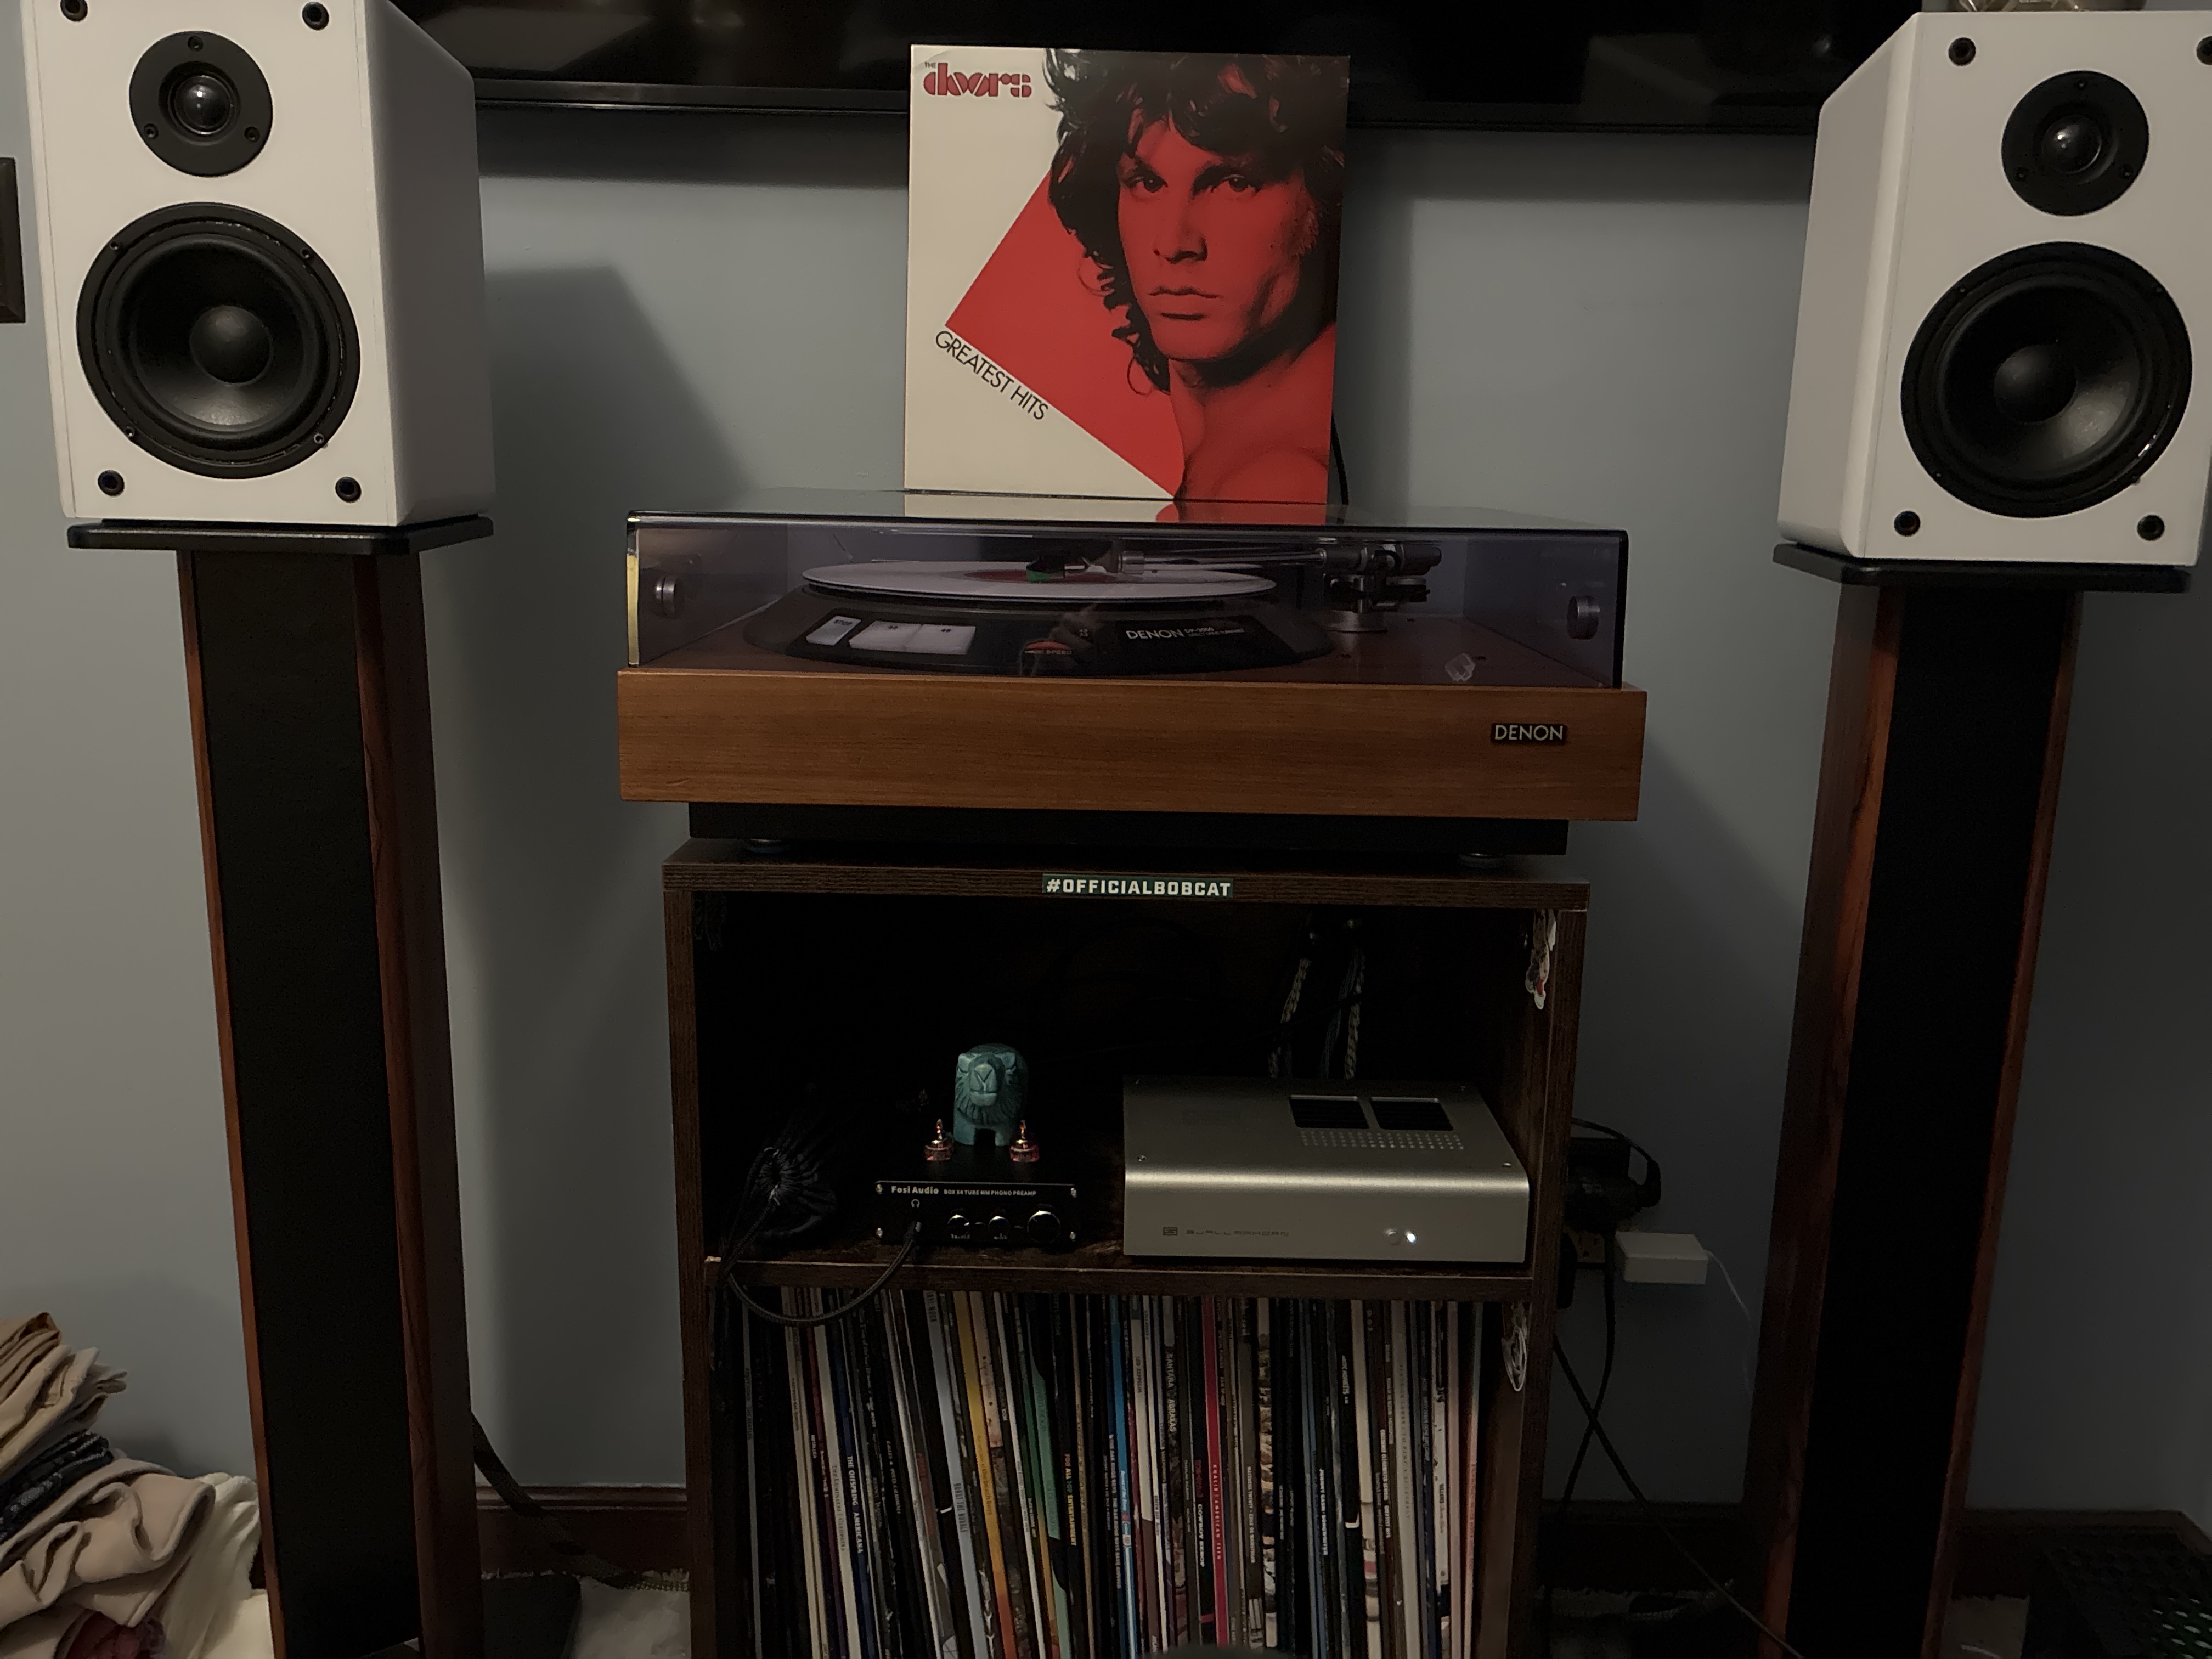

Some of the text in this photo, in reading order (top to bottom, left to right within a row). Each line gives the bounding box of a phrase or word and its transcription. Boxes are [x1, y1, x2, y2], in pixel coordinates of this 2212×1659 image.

[935, 331, 1049, 420] GREATEST HITS
[1125, 629, 1186, 639] DENON
[1494, 724, 1564, 741] DENON
[1046, 878, 1231, 897] #OFFICIALBOBCAT
[912, 1186, 939, 1194] Audio
[1166, 1353, 1177, 1432] SANTANA ABRAXAS
[849, 1470, 860, 1506] OFFSPRING
[853, 1512, 865, 1554] AMERICANA
